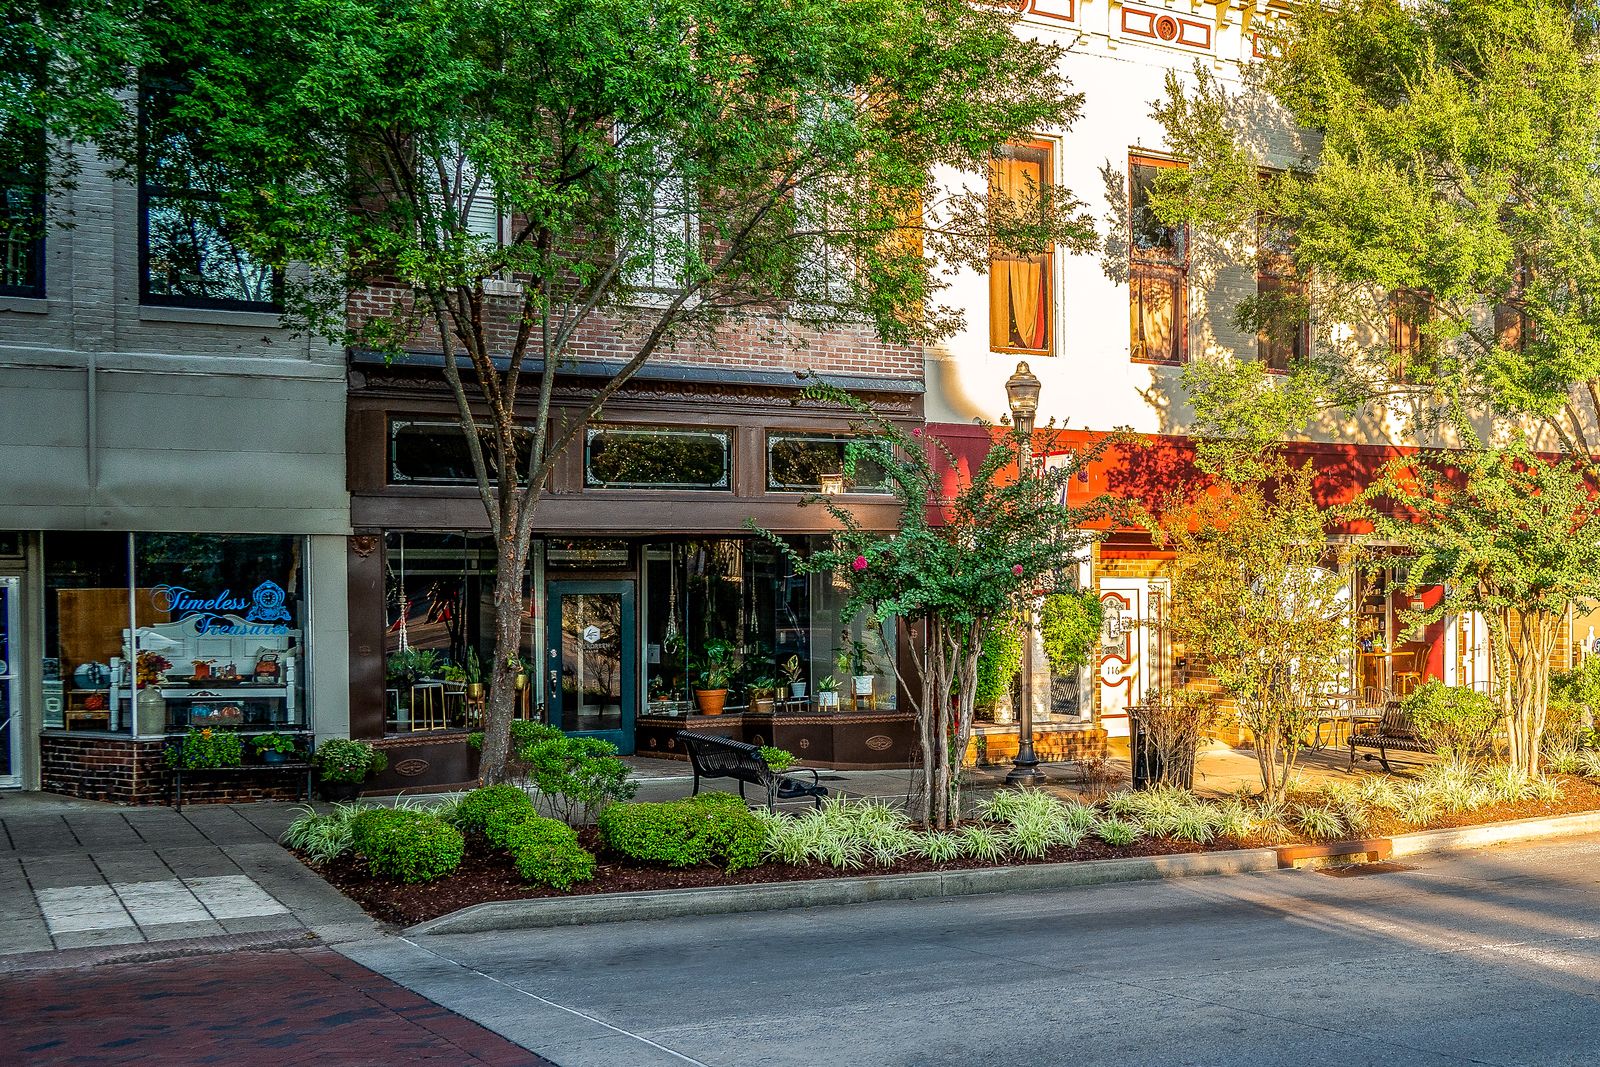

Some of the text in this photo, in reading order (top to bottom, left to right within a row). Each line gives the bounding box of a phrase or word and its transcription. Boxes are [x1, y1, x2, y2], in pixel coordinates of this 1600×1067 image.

[150, 584, 250, 612] Timeless
[180, 611, 289, 637] Treasures
[1107, 666, 1120, 675] 116
